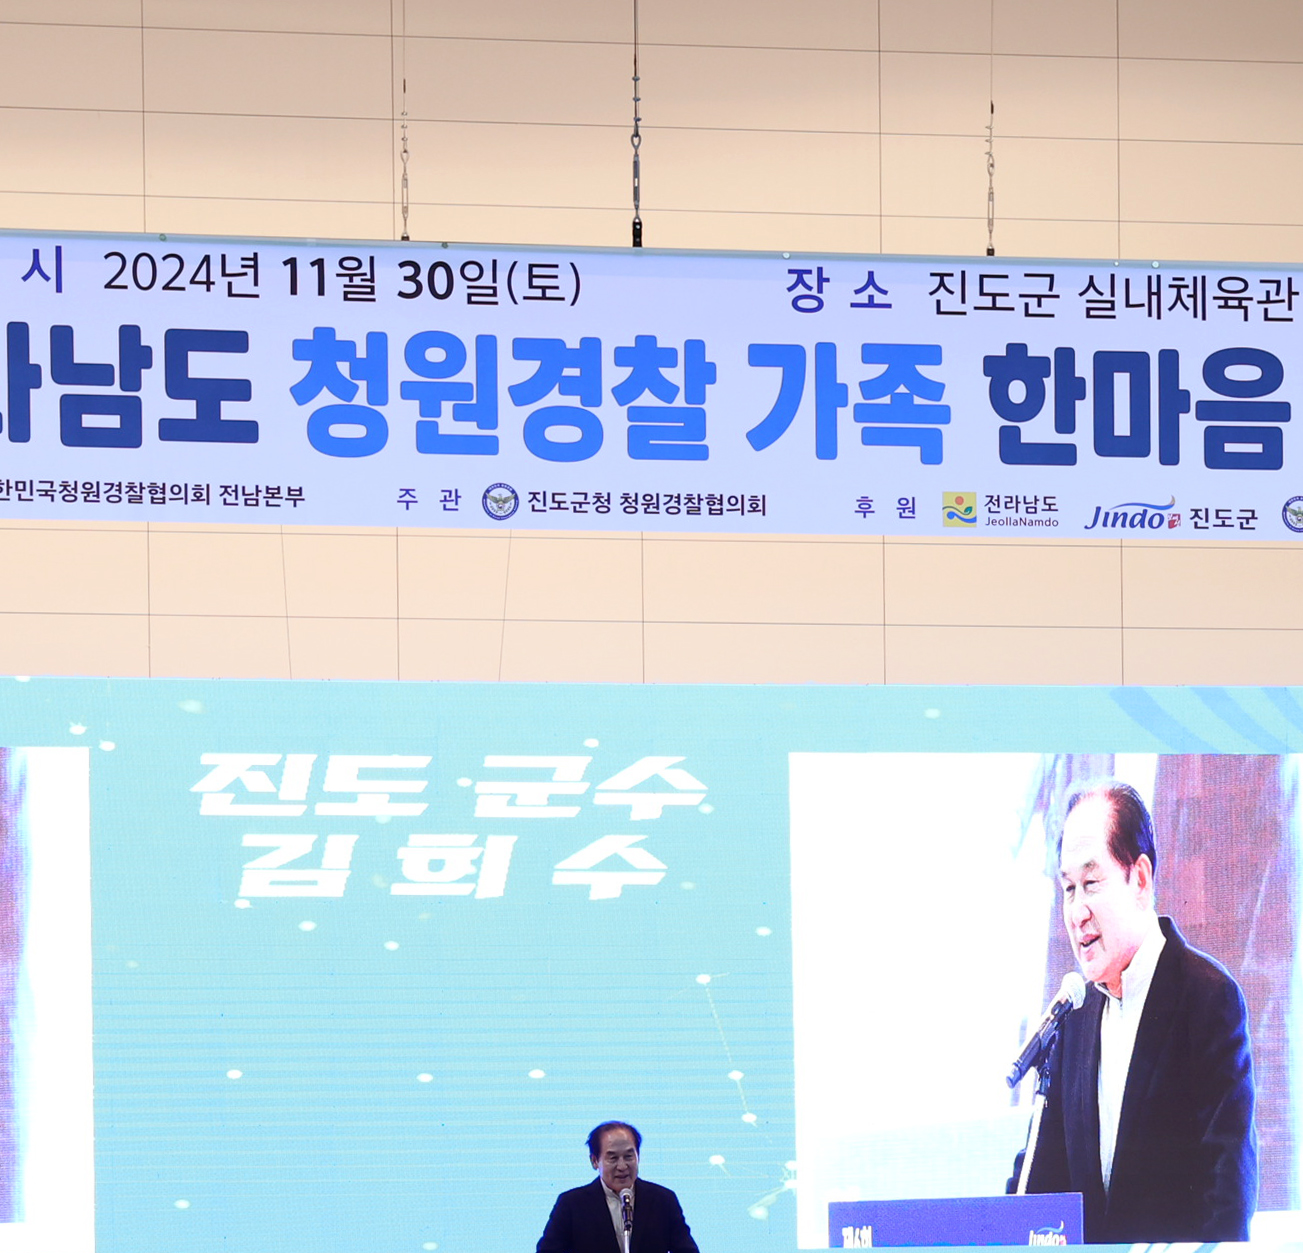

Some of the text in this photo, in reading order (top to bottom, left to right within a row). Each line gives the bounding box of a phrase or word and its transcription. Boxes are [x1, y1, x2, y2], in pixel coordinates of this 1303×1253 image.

[21, 245, 64, 294] 시
[102, 251, 581, 307] 2024년 11월 30일(토)
[786, 266, 893, 314] 장 소
[928, 270, 1300, 322] 진도군 실내체육관
[289, 326, 717, 463] 청원경찰
[745, 341, 952, 466] 가족
[982, 342, 1292, 471] 한마음
[219, 484, 306, 508] 전남본부
[396, 488, 462, 512] 주 관
[527, 490, 767, 517] 진도군청 청원경찰협의회
[854, 496, 917, 519] 후 원
[984, 494, 1059, 515] 전라남도
[985, 516, 1059, 528] JeollaNamdo
[1084, 503, 1165, 530] Jindo
[1189, 507, 1259, 531] 진도군
[190, 753, 709, 821] 진도 군수
[238, 833, 668, 900] 김 희 수
